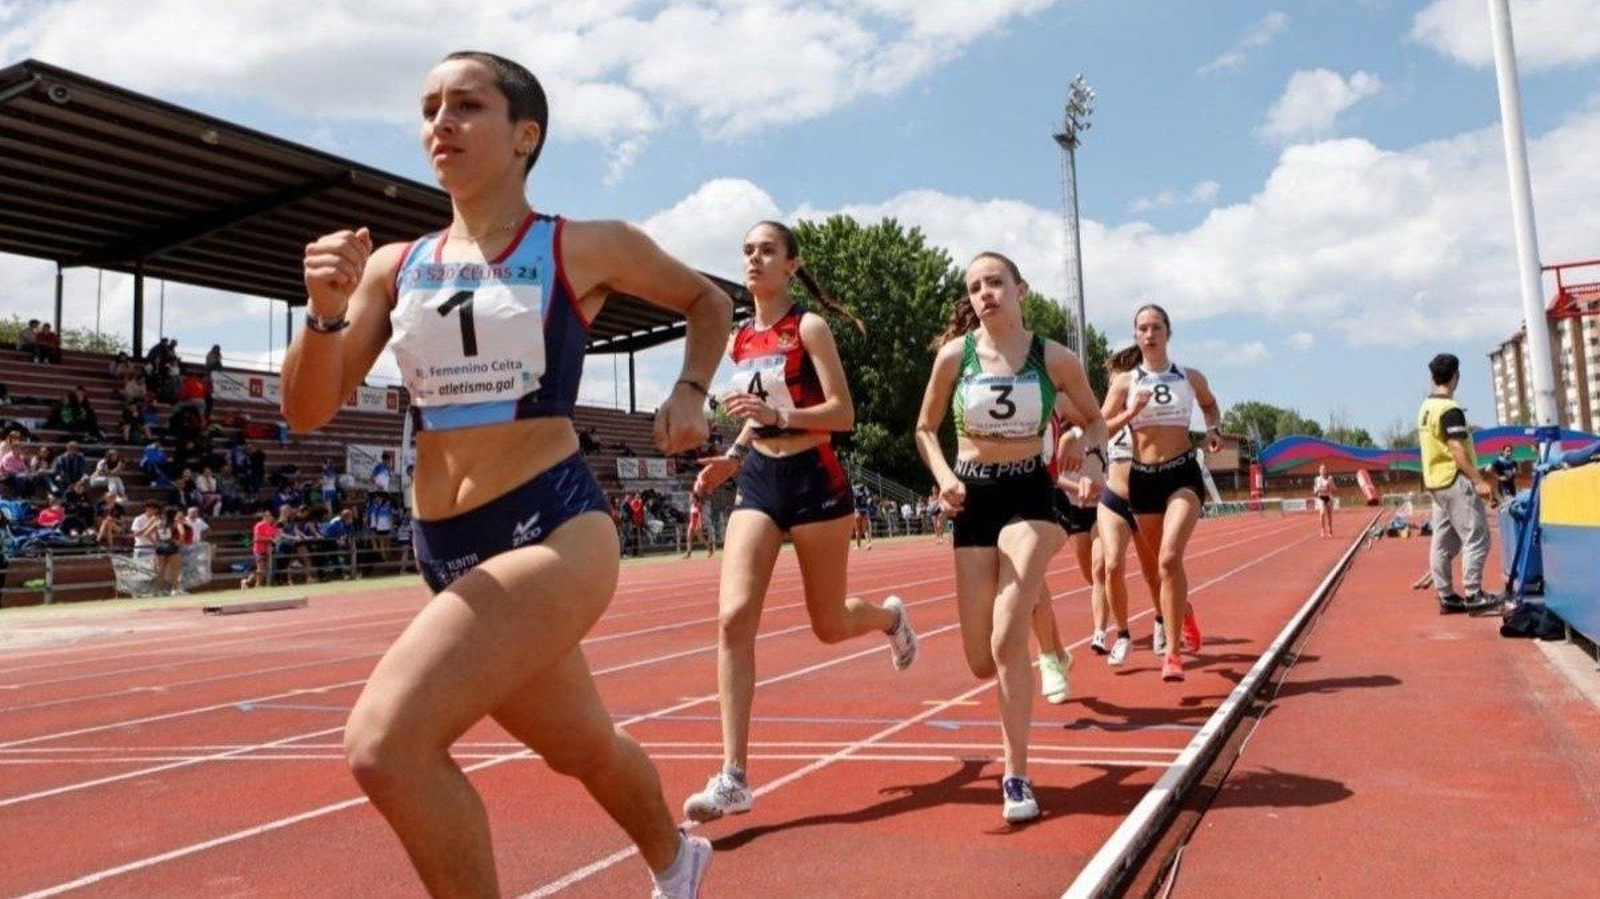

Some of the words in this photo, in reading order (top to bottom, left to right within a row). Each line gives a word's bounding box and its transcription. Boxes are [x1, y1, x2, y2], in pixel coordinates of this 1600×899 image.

[460, 262, 512, 280] CLUBS
[517, 265, 538, 280] 23
[437, 290, 478, 357] 1
[429, 360, 489, 378] Femenino
[491, 358, 523, 372] Celta
[748, 371, 769, 402] 4
[1153, 384, 1172, 404] 8
[989, 385, 1016, 419] 3
[954, 459, 991, 478] NIKE
[996, 457, 1036, 478] PRO
